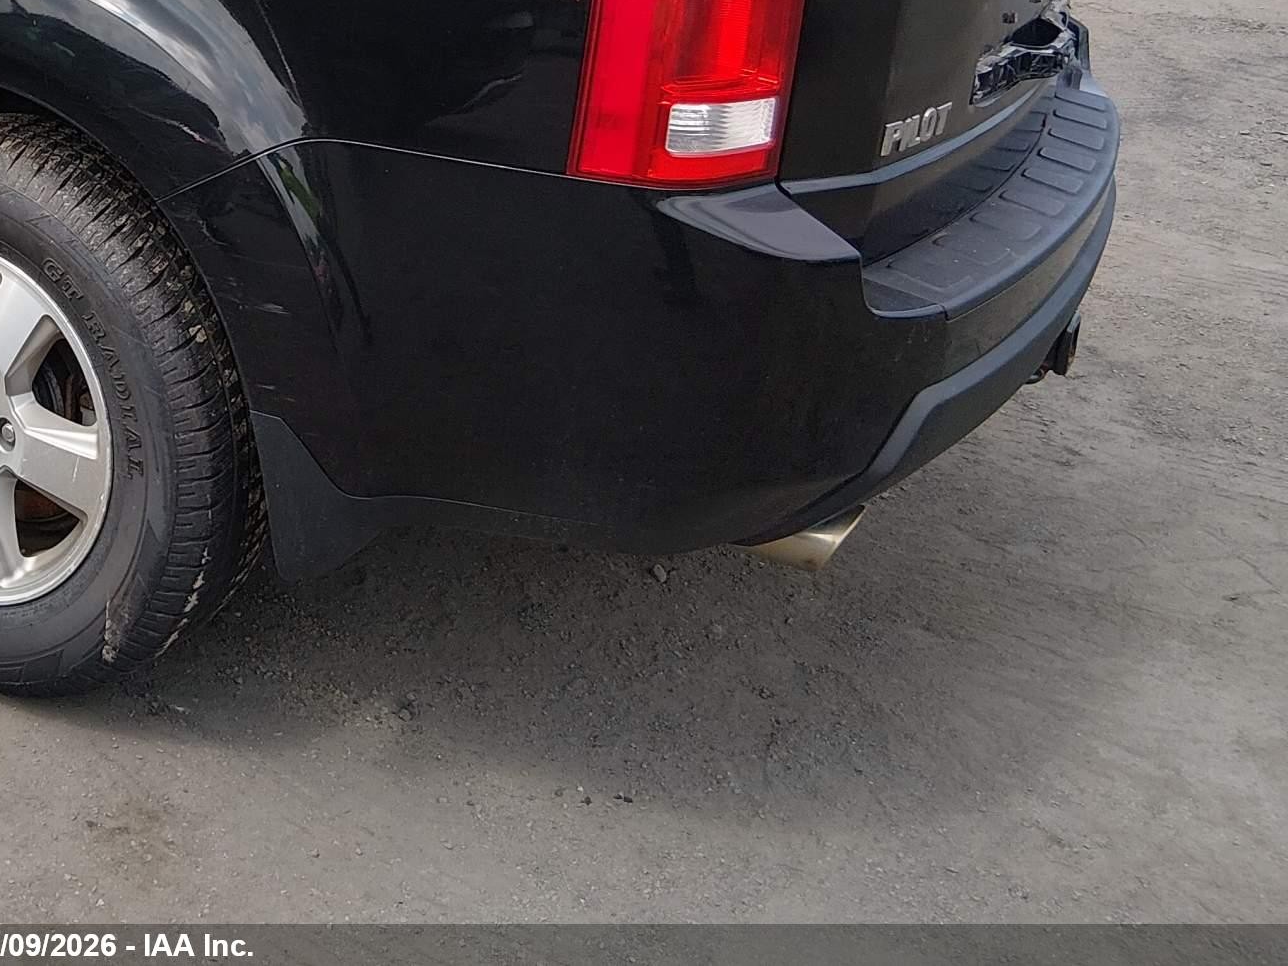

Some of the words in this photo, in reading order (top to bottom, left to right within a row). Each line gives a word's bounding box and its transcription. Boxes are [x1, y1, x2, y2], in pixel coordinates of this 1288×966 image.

[880, 101, 953, 157] PILOT
[41, 256, 85, 301] GT
[81, 309, 146, 481] RADIAL
